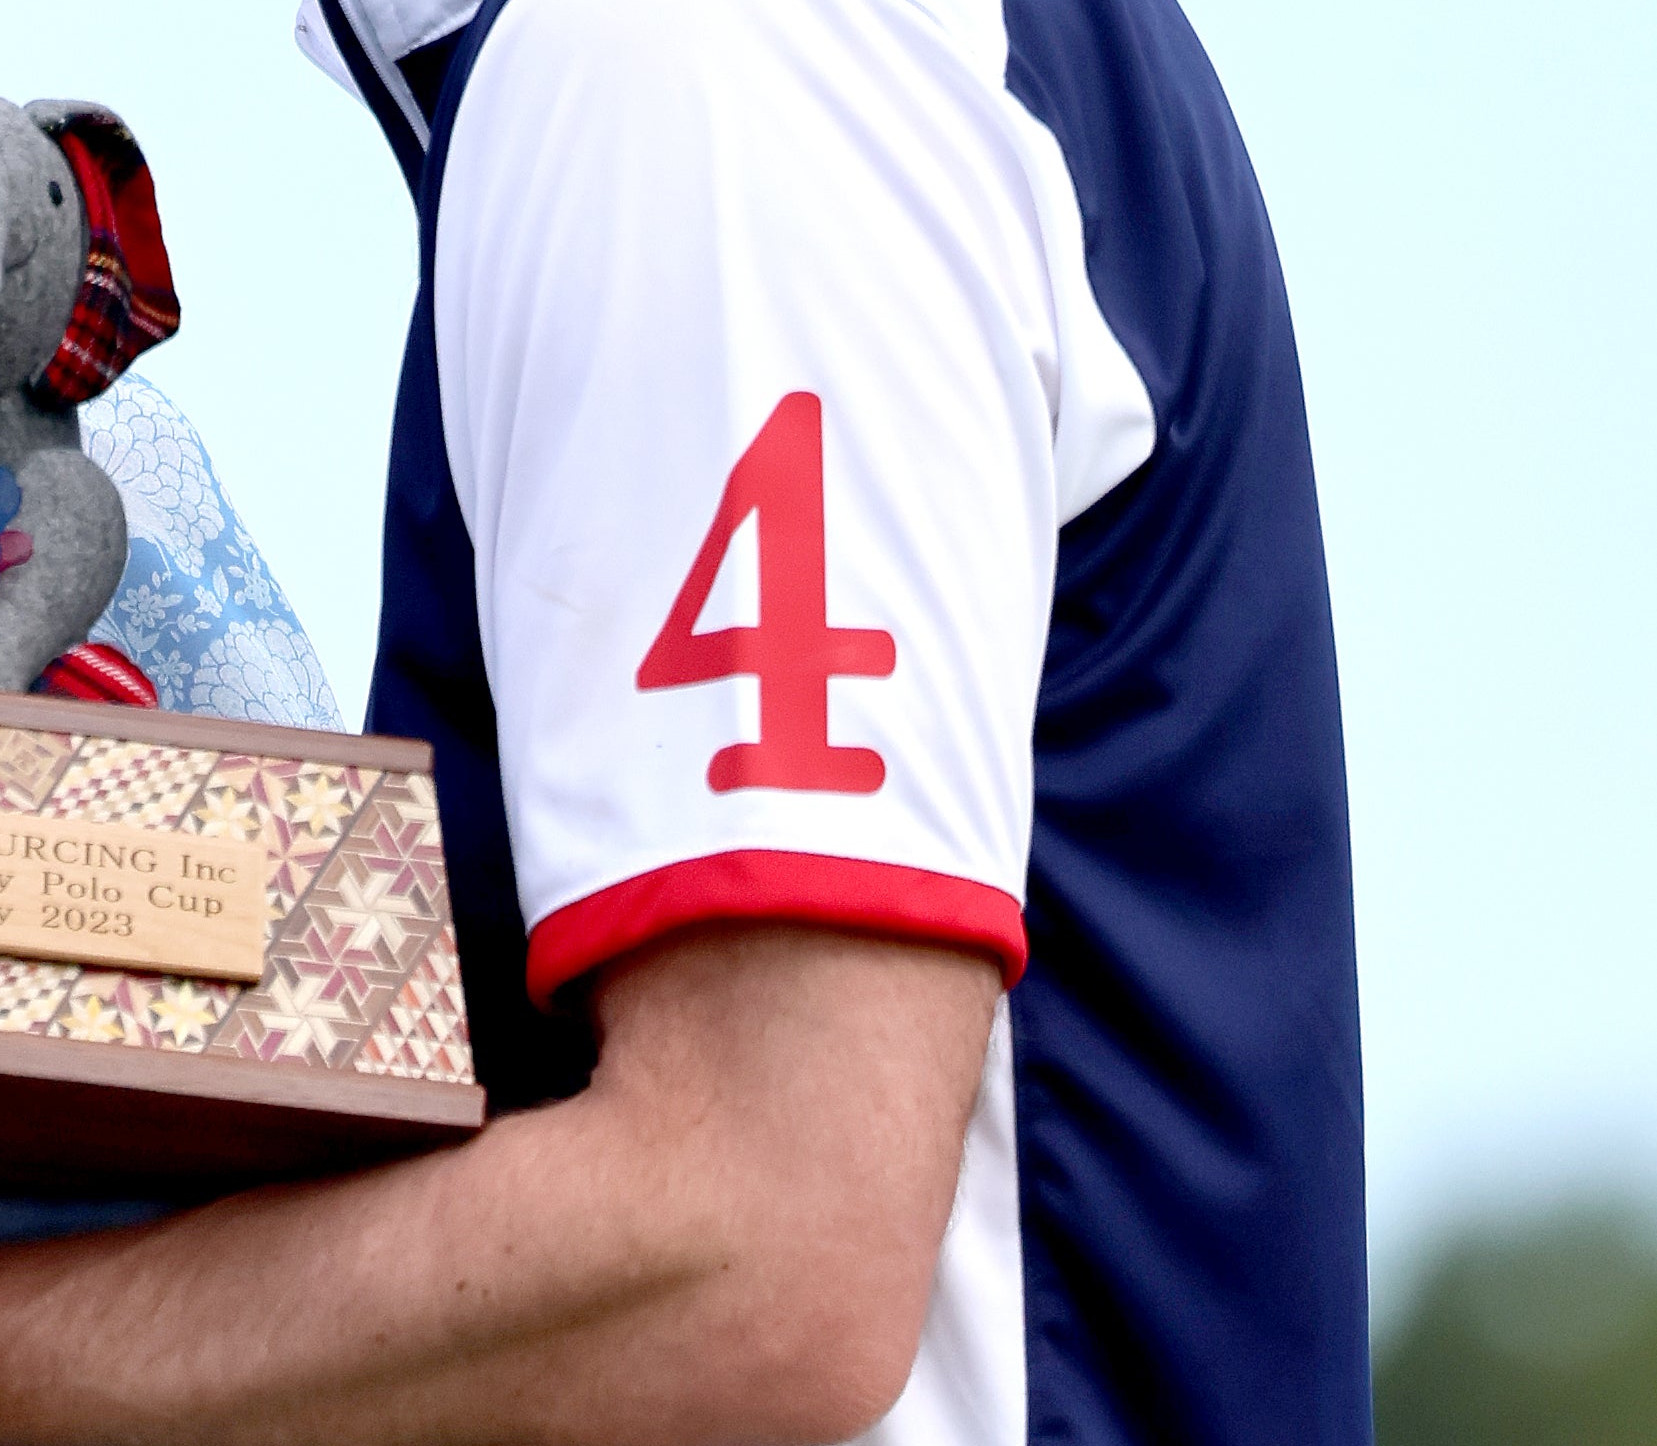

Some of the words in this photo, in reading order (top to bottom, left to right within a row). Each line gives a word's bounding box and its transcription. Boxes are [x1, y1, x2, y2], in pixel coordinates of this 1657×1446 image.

[636, 391, 896, 794] 4
[180, 855, 237, 884] Inc
[42, 871, 122, 903] Polo
[148, 886, 224, 917] Cup
[42, 905, 133, 937] 2023
